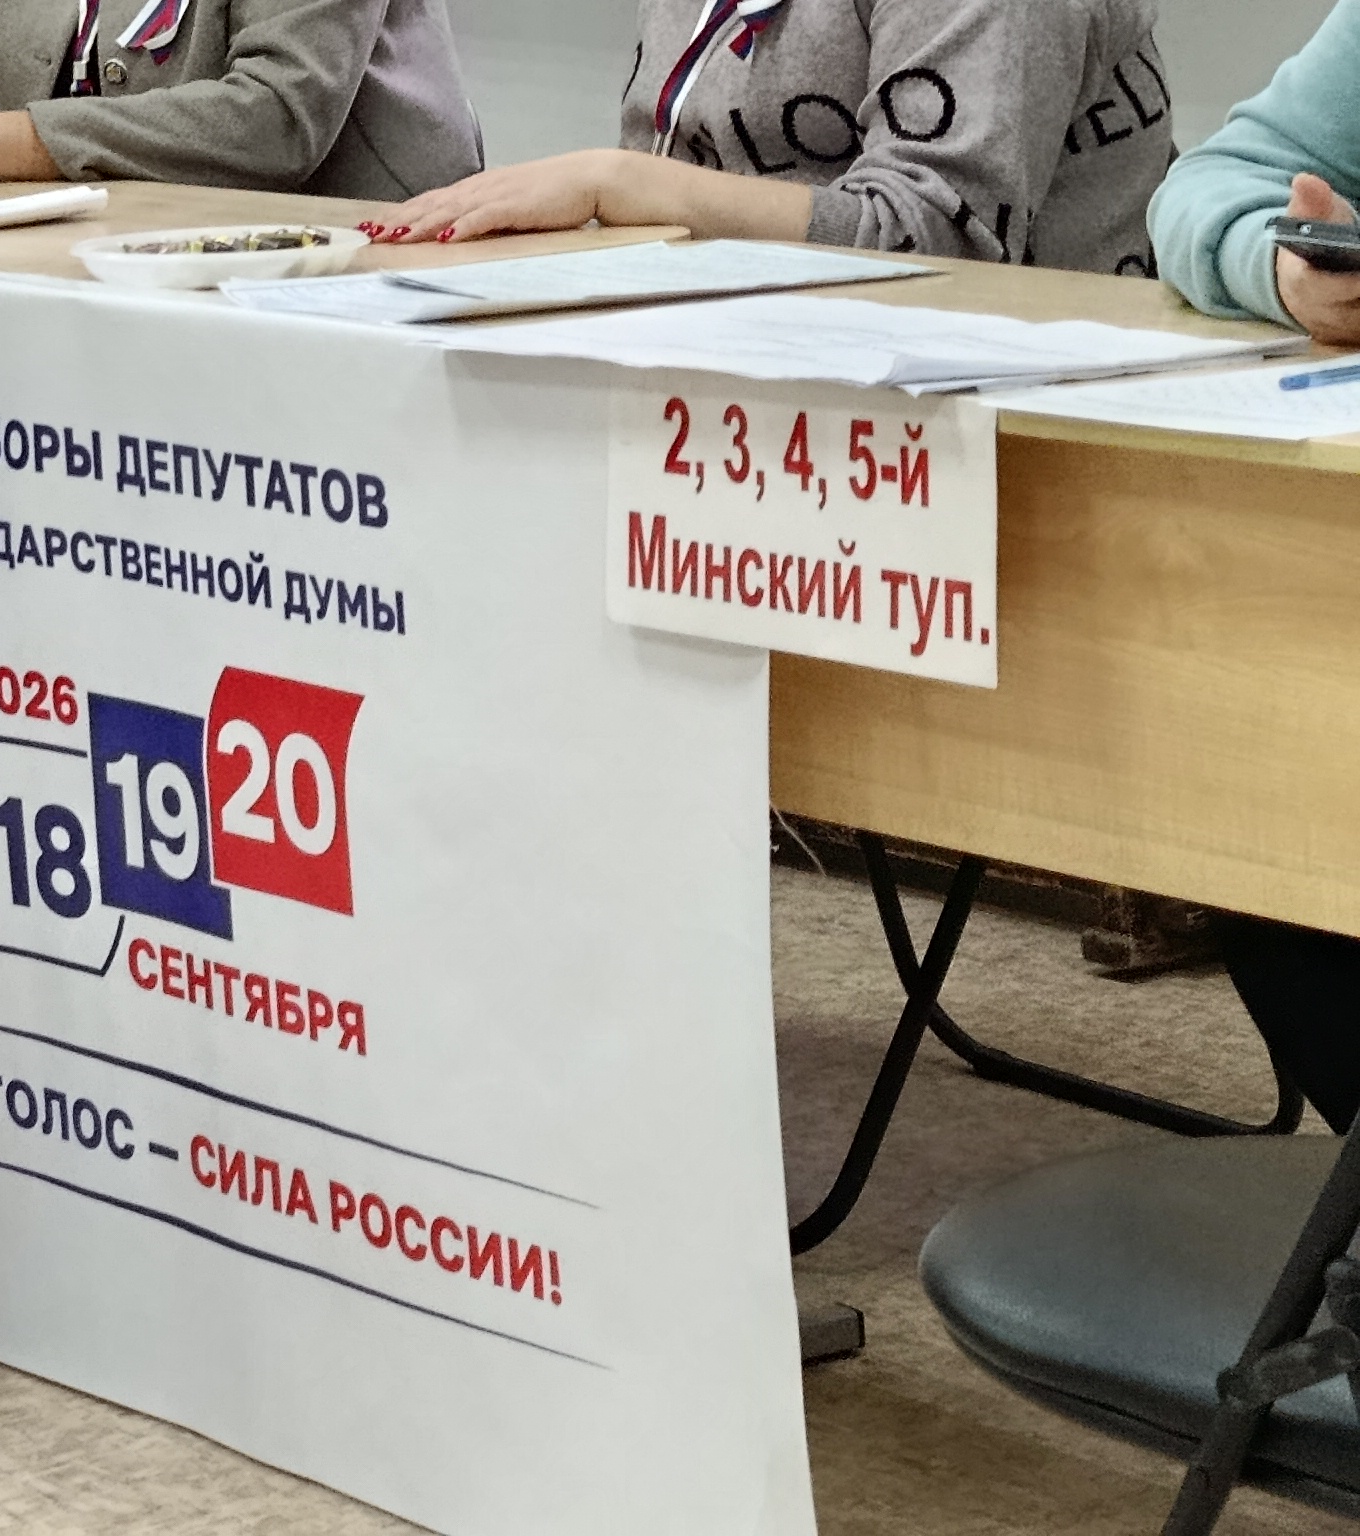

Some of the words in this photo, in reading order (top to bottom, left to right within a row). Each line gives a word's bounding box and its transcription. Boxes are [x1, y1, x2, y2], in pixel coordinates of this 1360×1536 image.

[116, 432, 391, 530] ДЕПУТАТОВ
[663, 396, 705, 494] 2,
[723, 404, 765, 502] 3,
[783, 411, 827, 510] 4,
[848, 419, 930, 508] 5-й
[283, 569, 407, 637] ДУМЫ
[628, 510, 862, 624] Минский
[880, 569, 990, 657] туп.
[104, 750, 201, 881] 19
[216, 716, 338, 859] 20
[127, 936, 368, 1057] СЕНТЯБРЯ
[189, 1133, 319, 1225] СИЛА
[330, 1190, 565, 1307] РОССИИ!
